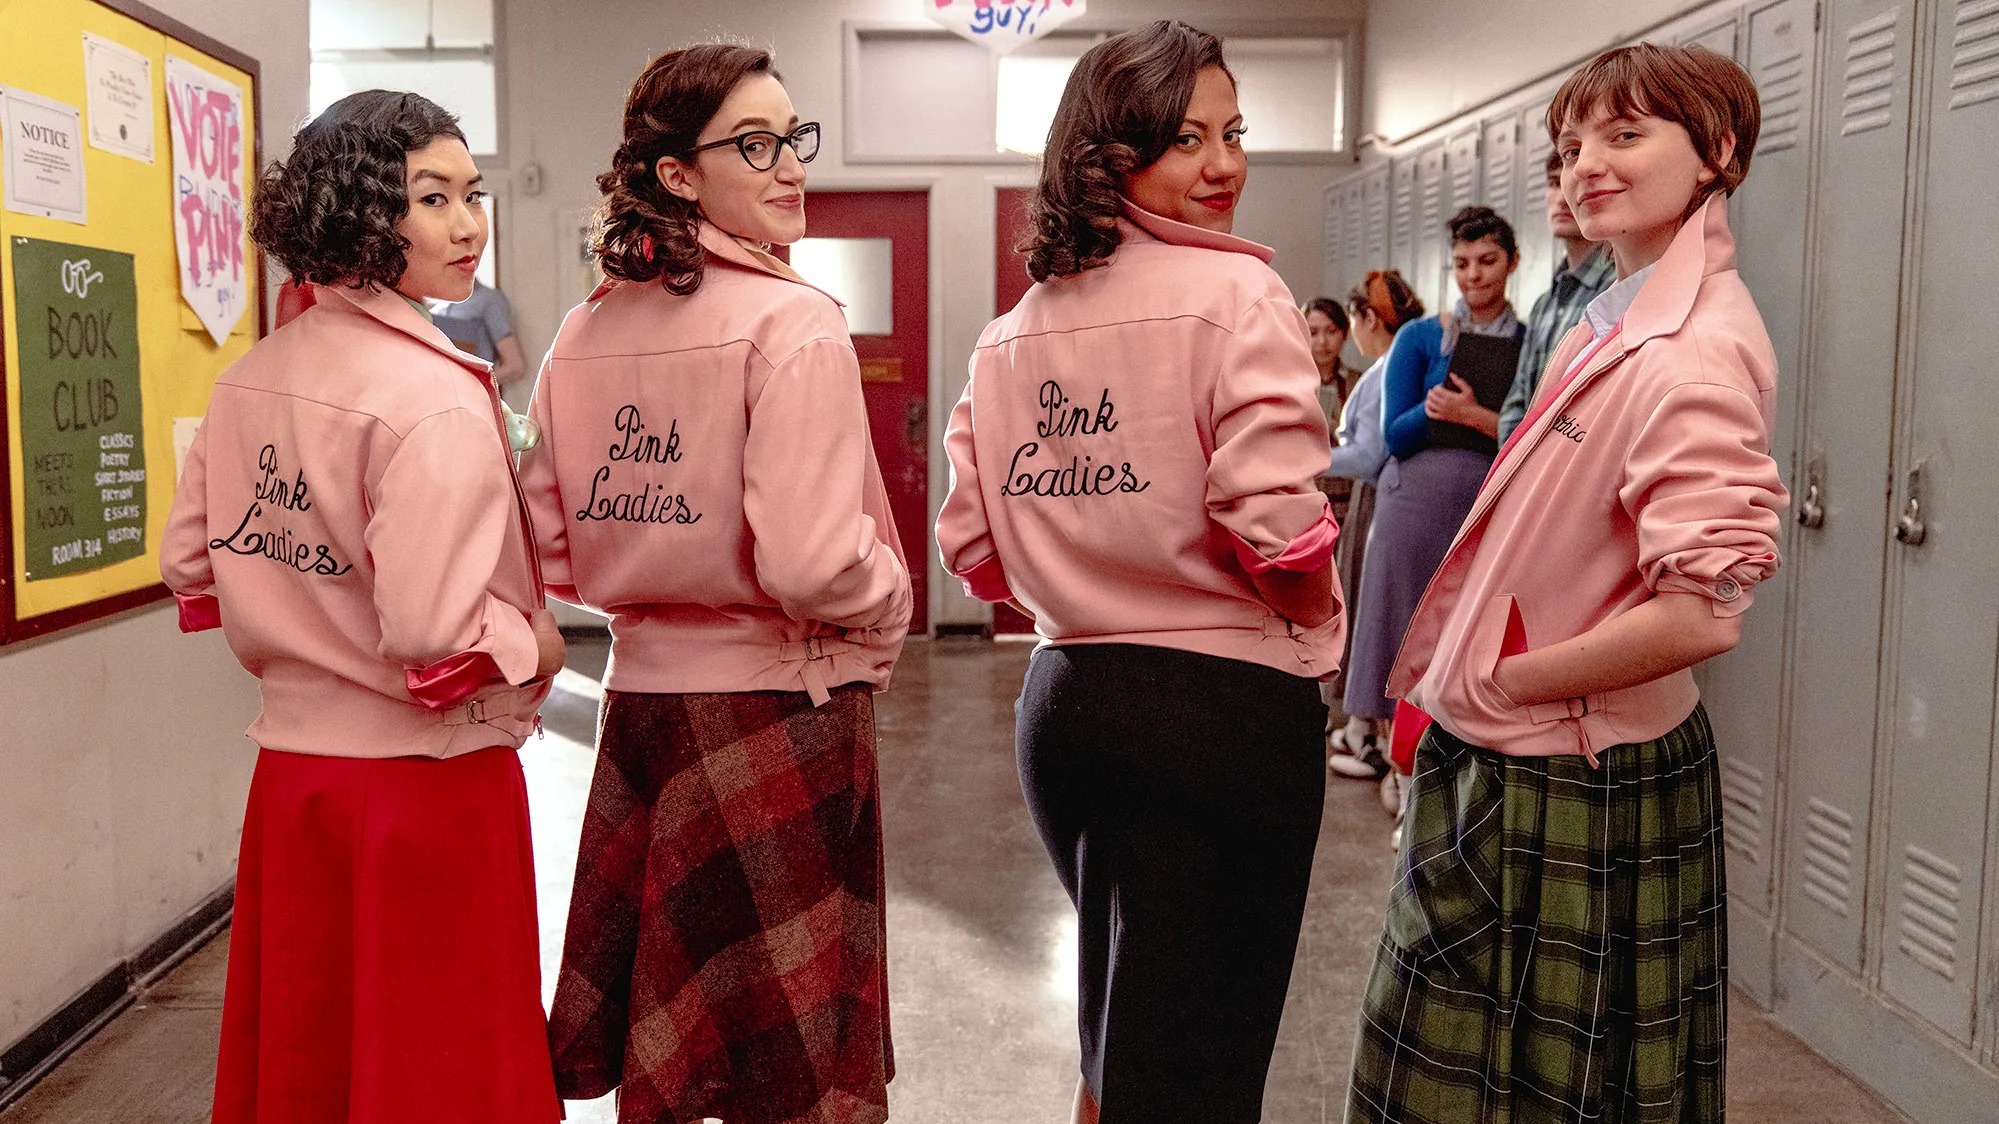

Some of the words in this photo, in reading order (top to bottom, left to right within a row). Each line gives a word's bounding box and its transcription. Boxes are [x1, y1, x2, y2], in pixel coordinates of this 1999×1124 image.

[20, 120, 70, 149] NOTICE
[168, 81, 240, 199] VOTE
[180, 194, 243, 288] PINK
[47, 306, 118, 359] BOOK
[53, 378, 119, 431] CLUB
[1037, 380, 1119, 438] Pink
[99, 432, 134, 449] CLASSICS
[100, 451, 130, 468] POETRY
[608, 404, 682, 464] Pink
[95, 470, 117, 486] SHORT
[117, 469, 145, 483] STORIES
[101, 485, 134, 502] FICTION
[255, 444, 312, 511] Pink
[576, 466, 702, 524] Ladies
[1001, 442, 1151, 497] Ladies
[103, 504, 139, 522] ESSAYS
[107, 526, 143, 544] HISTORY
[209, 502, 353, 576] Ladies
[52, 538, 83, 565] ROOM
[84, 537, 103, 558] 314
